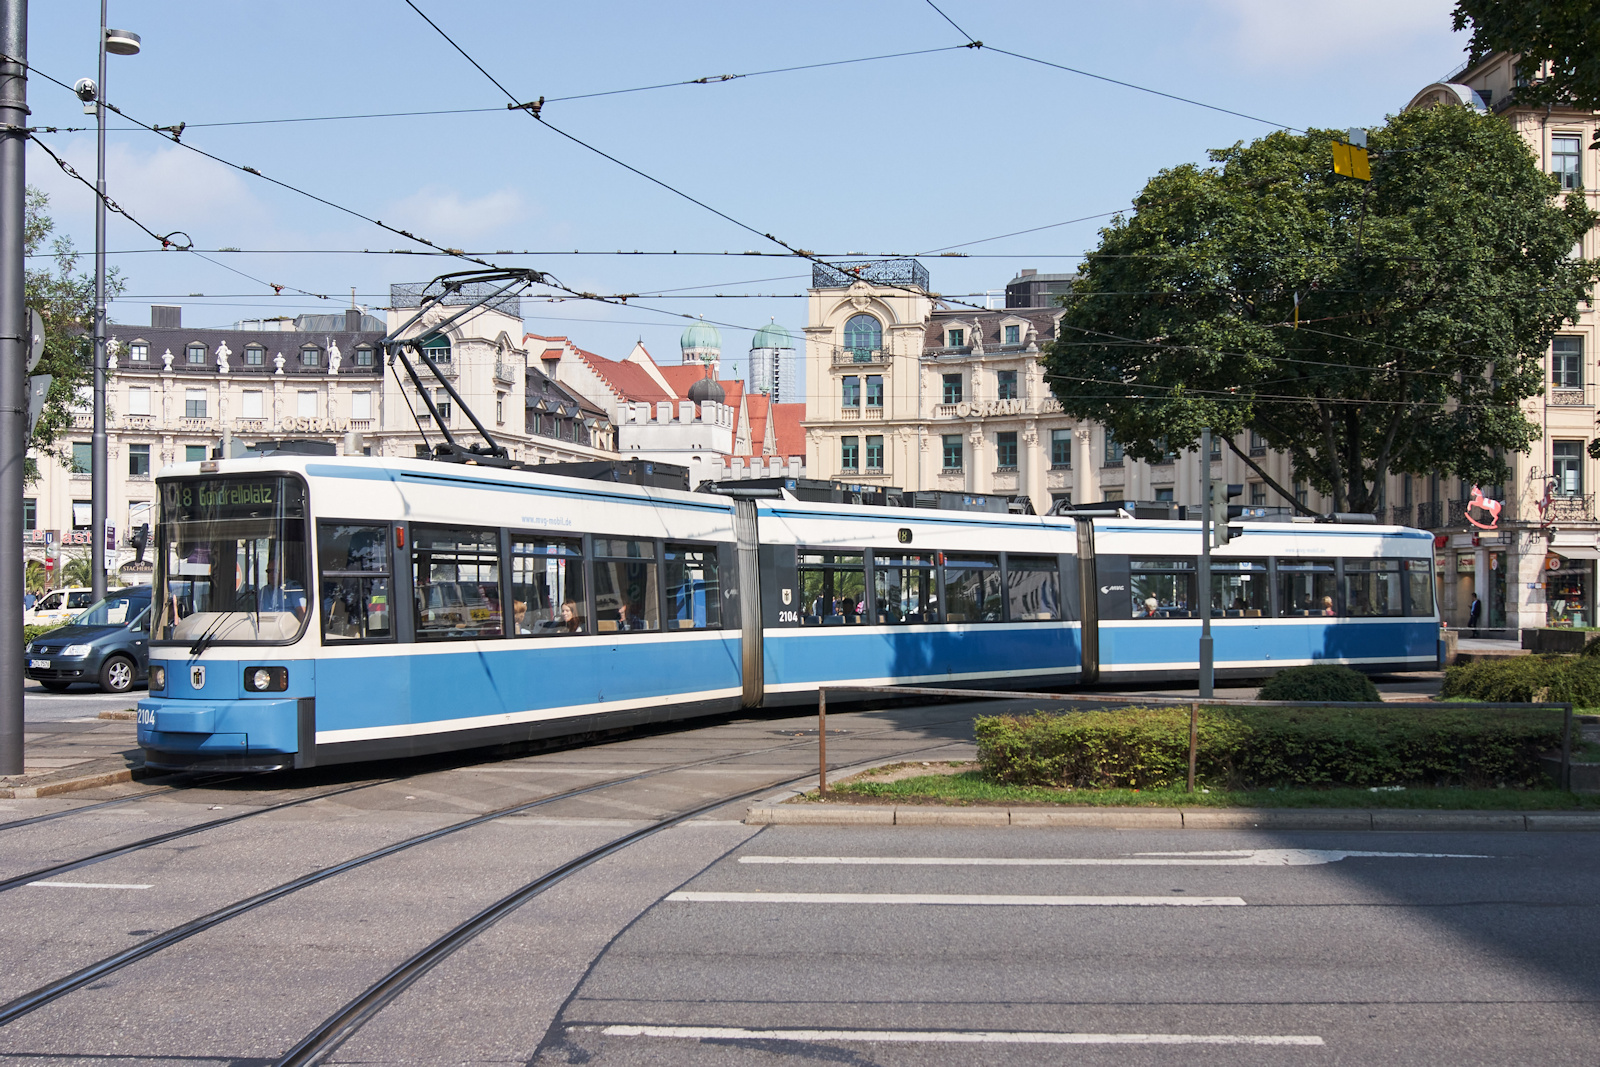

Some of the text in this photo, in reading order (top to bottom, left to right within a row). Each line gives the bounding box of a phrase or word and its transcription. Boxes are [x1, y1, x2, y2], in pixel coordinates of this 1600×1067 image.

[957, 399, 1025, 417] OSRAM
[282, 416, 352, 433] OSRAM
[176, 484, 272, 507] 18 Gondrellplatz
[521, 516, 572, 526] www.mvg-mobil.de
[46, 533, 52, 542] U
[898, 530, 908, 542] 18
[779, 611, 798, 622] 2104
[138, 708, 155, 725] 2104
